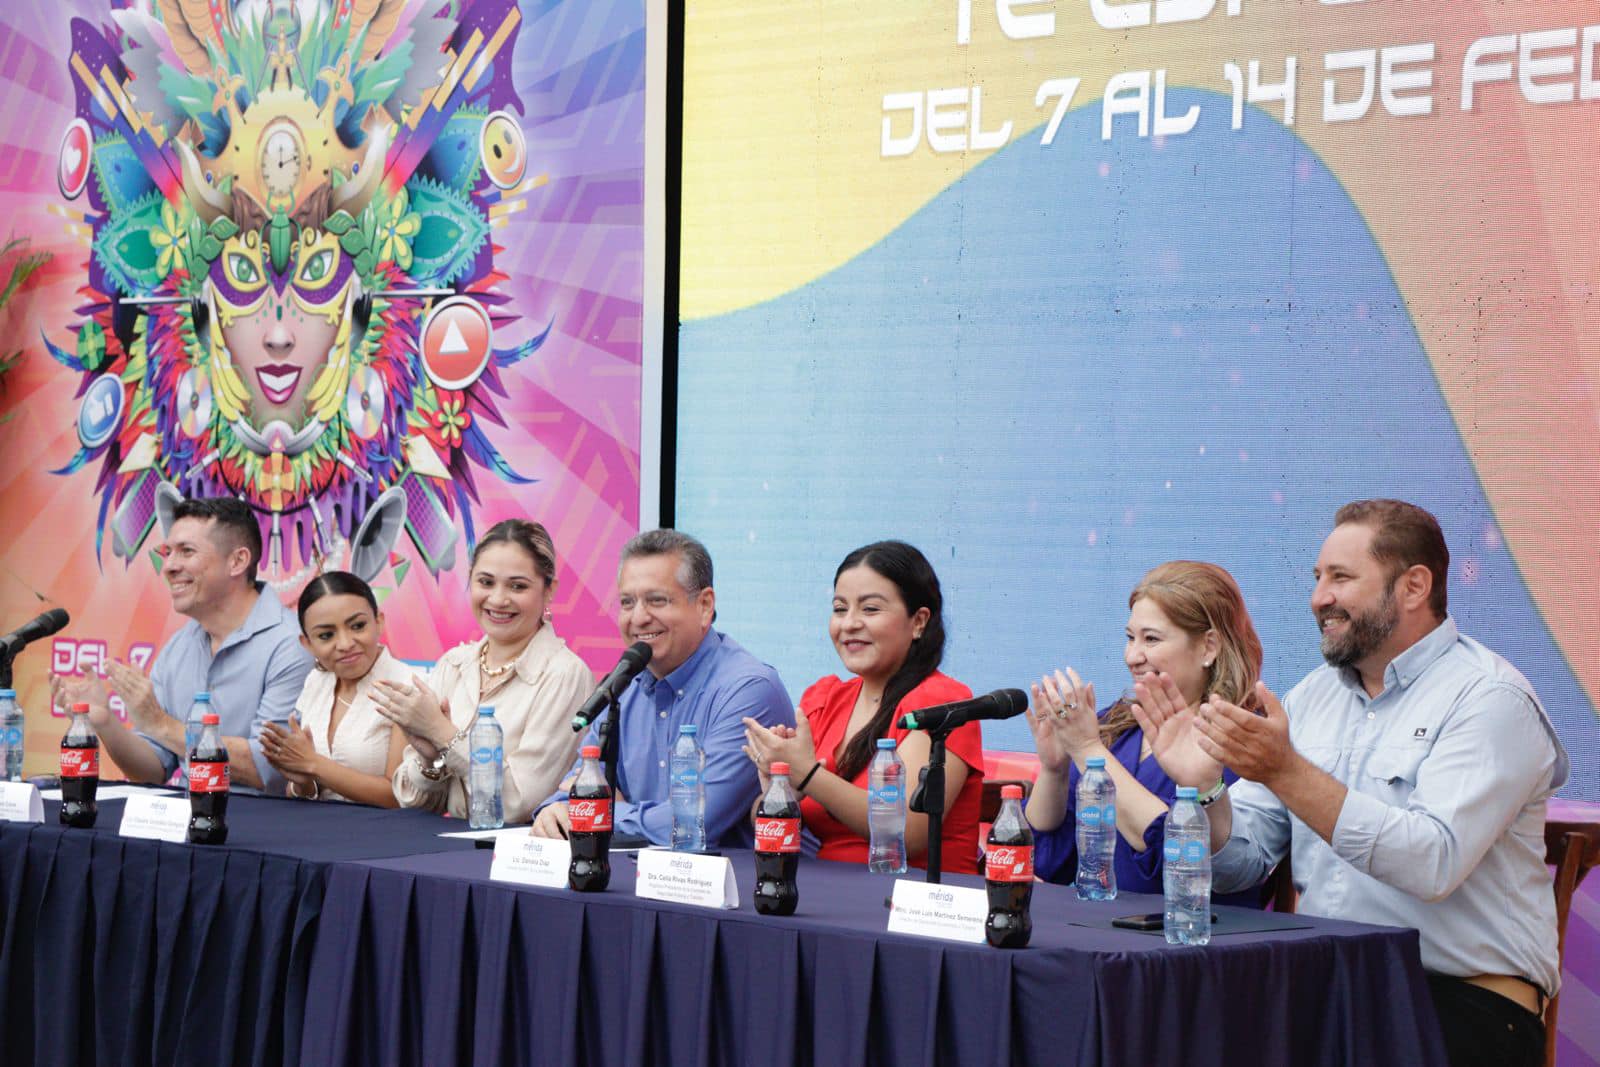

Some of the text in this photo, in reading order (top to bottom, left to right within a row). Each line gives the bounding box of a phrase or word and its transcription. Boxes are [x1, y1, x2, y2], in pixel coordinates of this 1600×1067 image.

[881, 86, 1013, 158] DEL
[1035, 77, 1081, 146] 7
[1102, 69, 1201, 140] AL
[1224, 56, 1298, 130] 14
[1323, 43, 1436, 122] DE
[928, 888, 953, 902] mérida
